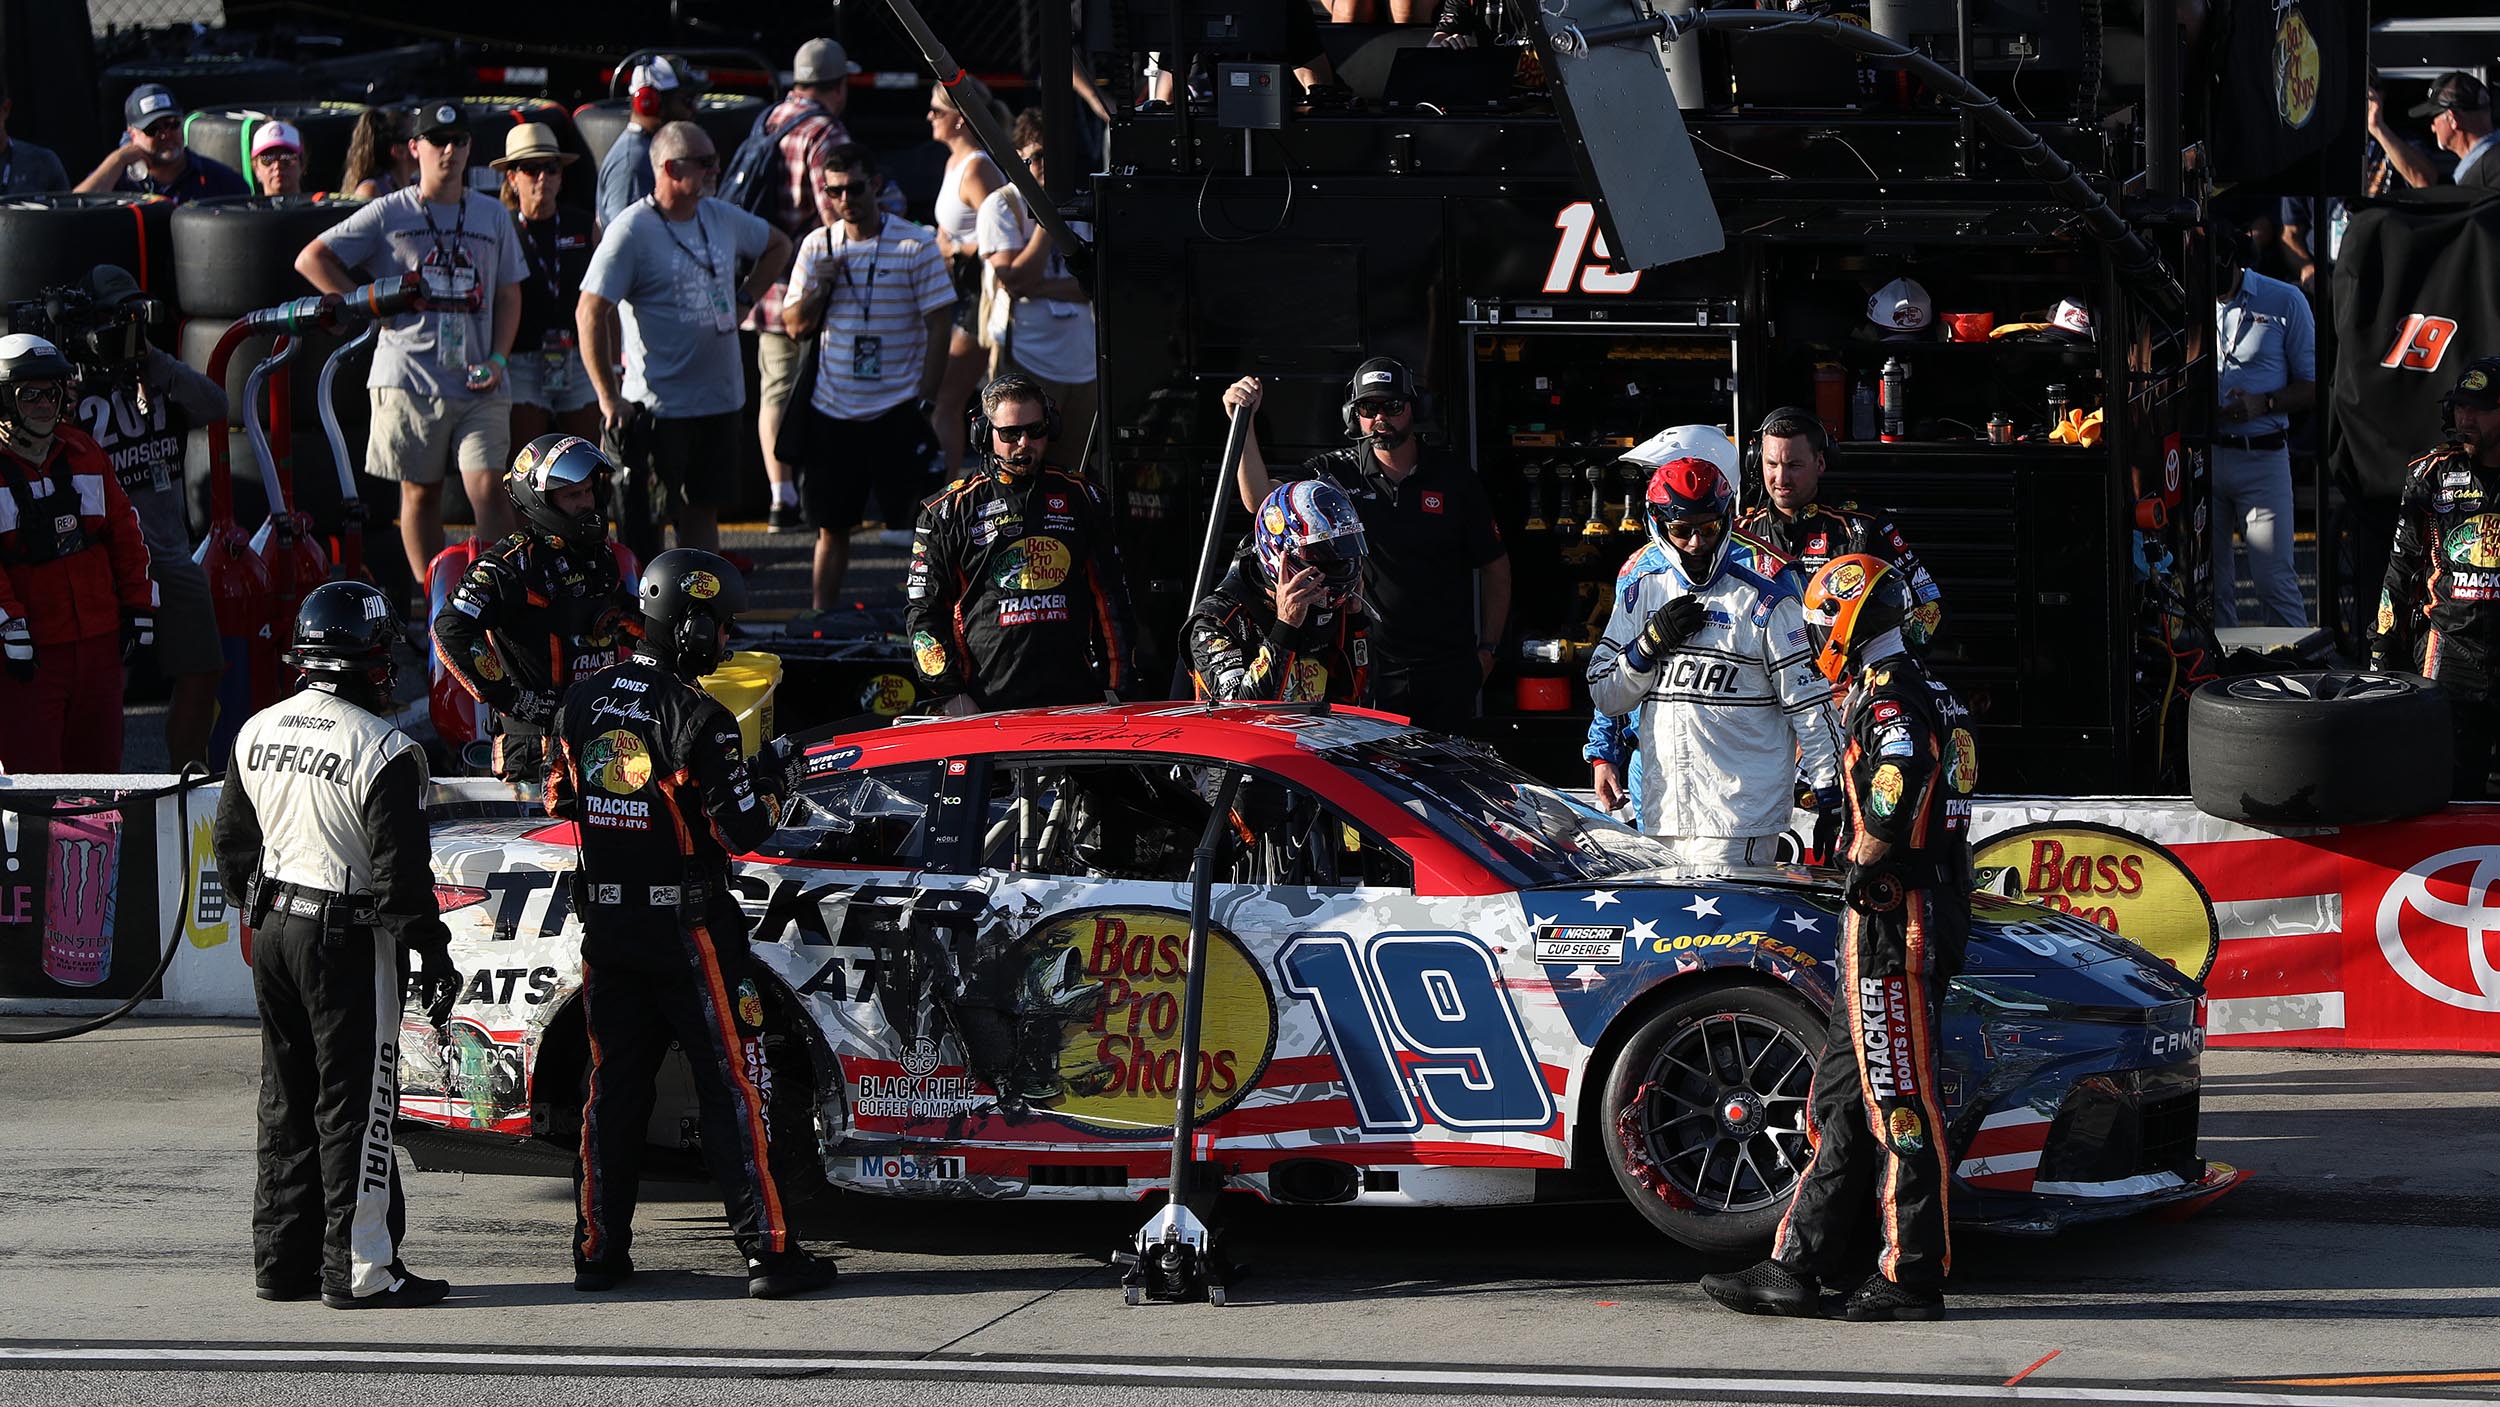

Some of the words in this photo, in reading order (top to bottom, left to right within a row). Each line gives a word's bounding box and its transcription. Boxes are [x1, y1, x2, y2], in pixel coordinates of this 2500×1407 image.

[2379, 312, 2457, 372] 19
[2480, 514, 2500, 530] Ba
[1027, 538, 1059, 556] Bass
[1030, 553, 1053, 567] Pro
[1031, 566, 1067, 583] Shops
[2452, 571, 2500, 589] TRACK
[998, 594, 1068, 614] TRACKER
[1003, 612, 1037, 625] BOATS
[258, 623, 273, 639] 4
[611, 677, 649, 693] JONES
[294, 715, 336, 733] NASCAR
[615, 732, 640, 751] Bass
[248, 743, 353, 787] OFFICIAL
[615, 750, 630, 766] Pro
[613, 765, 647, 785] Shops
[587, 796, 650, 818] TRACKER
[588, 814, 617, 827] BOATS
[625, 815, 649, 829] ATVs
[2024, 838, 2145, 896] Bass
[290, 899, 321, 916] SCAR
[1564, 927, 1614, 940] NASCAR
[50, 944, 105, 959] ENERGY
[1547, 943, 1569, 955] CUP
[1571, 943, 1611, 956] SERIES
[1651, 930, 1817, 968] GOODYEAR
[1087, 977, 1178, 1037] Pro
[1890, 980, 1906, 1023] ATVs
[1274, 931, 1557, 1133] 19
[1860, 976, 1897, 1101] TRACKER
[1896, 1041, 1914, 1092] BOATS
[859, 1076, 921, 1101] BLACK
[926, 1076, 975, 1101] RIFLE
[361, 1041, 395, 1194] OFFICIAL
[858, 1099, 908, 1118] COFFEE
[913, 1099, 974, 1119] COMPANY
